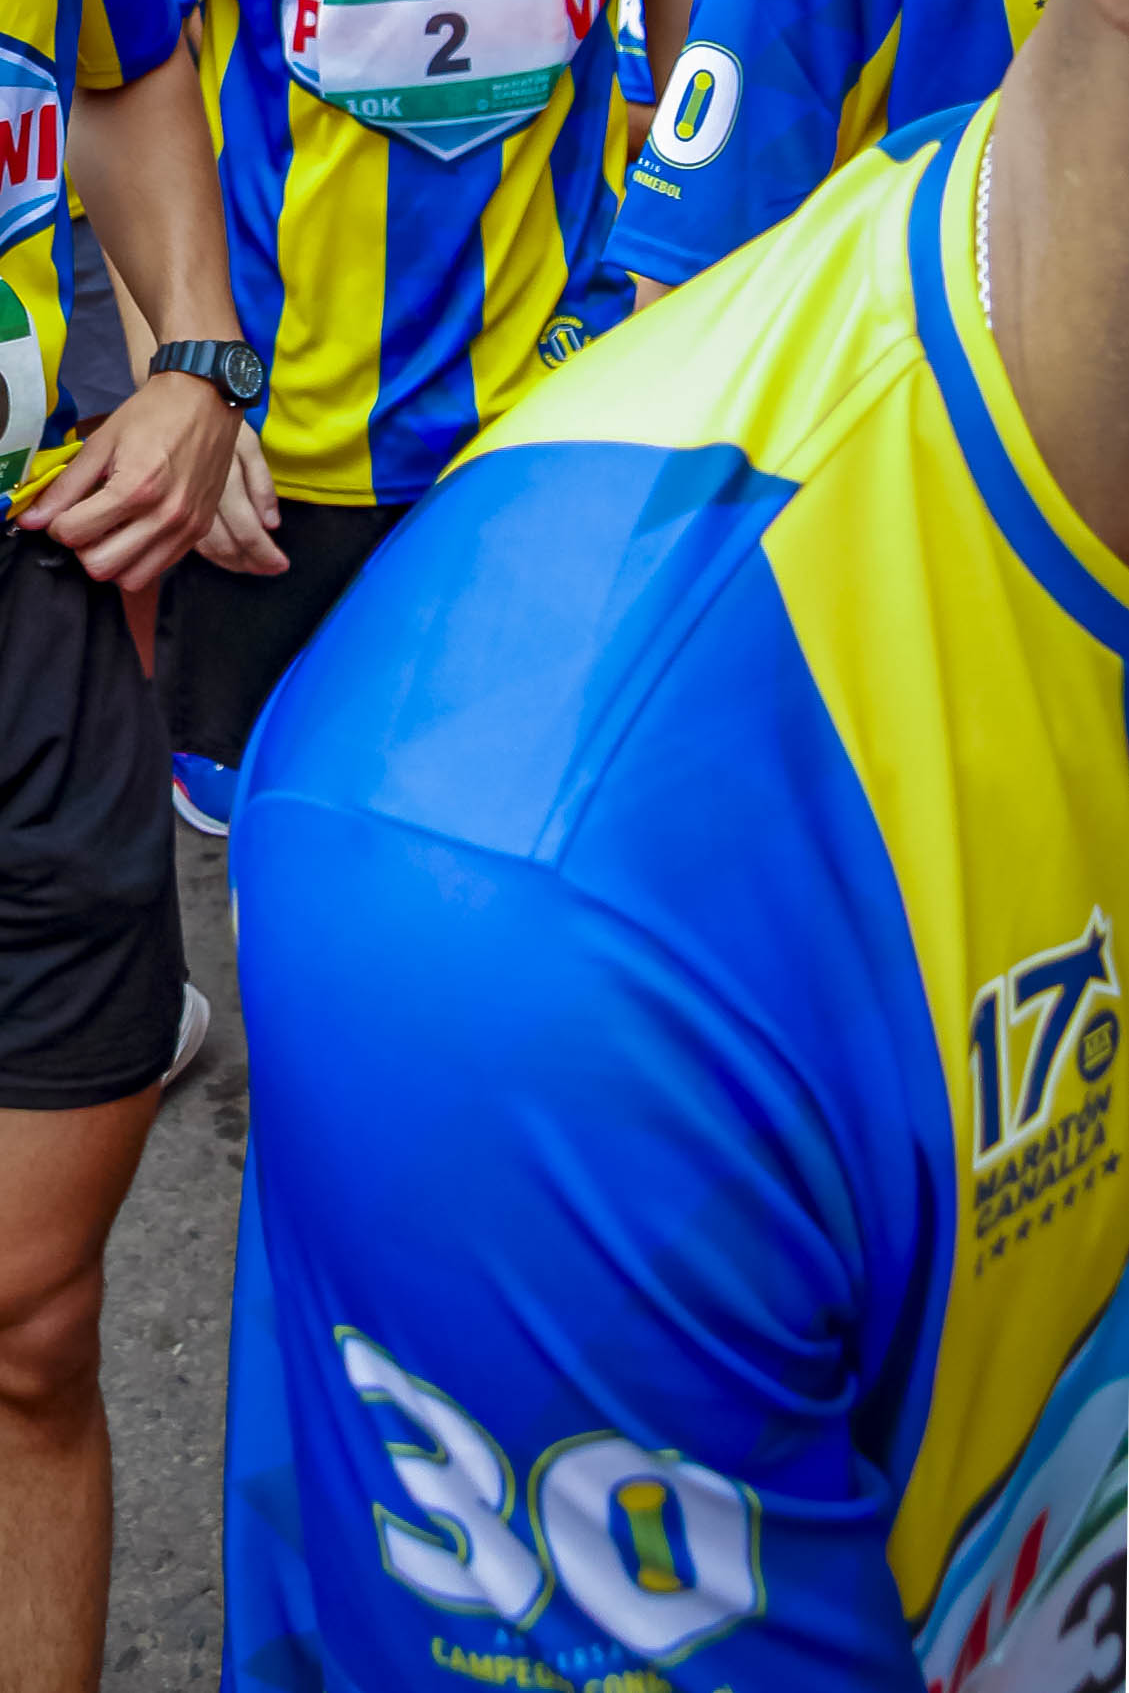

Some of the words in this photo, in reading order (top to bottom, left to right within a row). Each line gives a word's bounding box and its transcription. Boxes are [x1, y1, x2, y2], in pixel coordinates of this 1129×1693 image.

[345, 96, 403, 117] 10K
[424, 12, 472, 77] 2
[970, 907, 1120, 1170] 17
[974, 1082, 1113, 1211] MARATÓN
[975, 1120, 1106, 1240] CANALLA
[336, 1326, 765, 1663] 30
